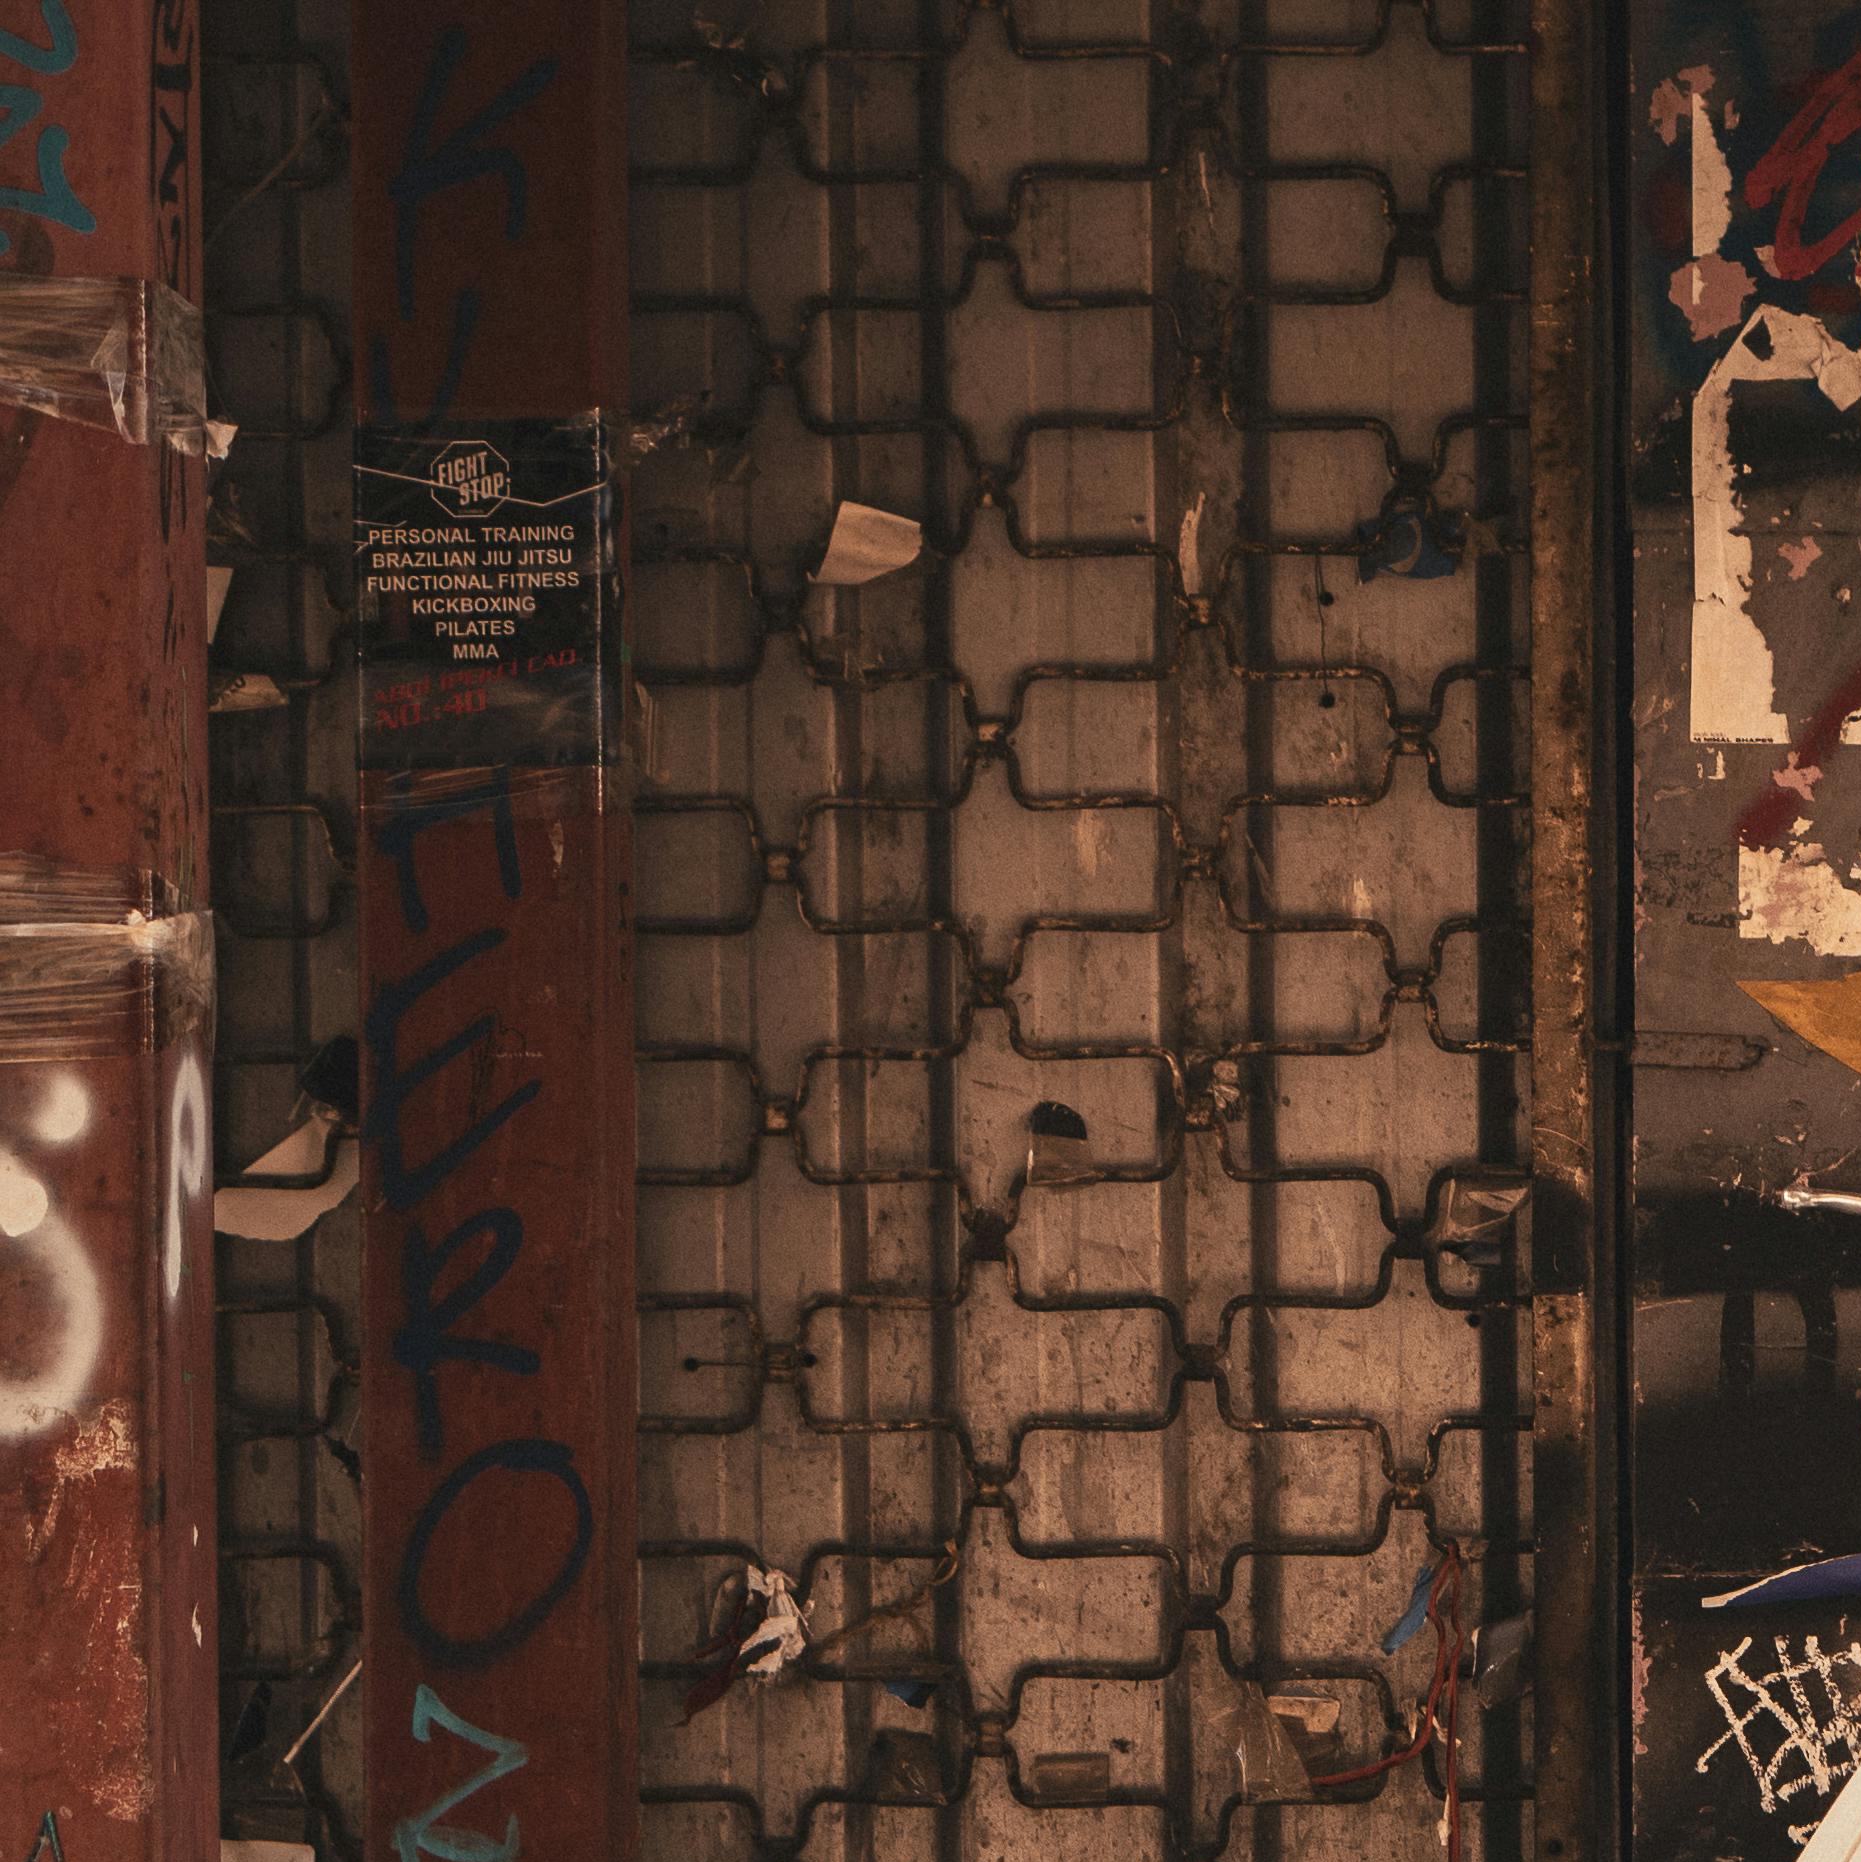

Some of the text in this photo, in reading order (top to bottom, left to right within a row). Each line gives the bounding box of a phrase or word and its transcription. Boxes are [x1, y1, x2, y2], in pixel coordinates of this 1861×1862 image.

[437, 451, 488, 486] FIGHT
[458, 472, 504, 506] STOP
[369, 525, 575, 546] PERSONAL TRAINING
[372, 549, 572, 569] BRAZILIAN JIU JITSU
[367, 572, 579, 592] FUNCTIONAL FITNESS
[412, 596, 536, 614] KICKBOXING
[435, 619, 516, 637] PILATES
[452, 644, 500, 660] MMA
